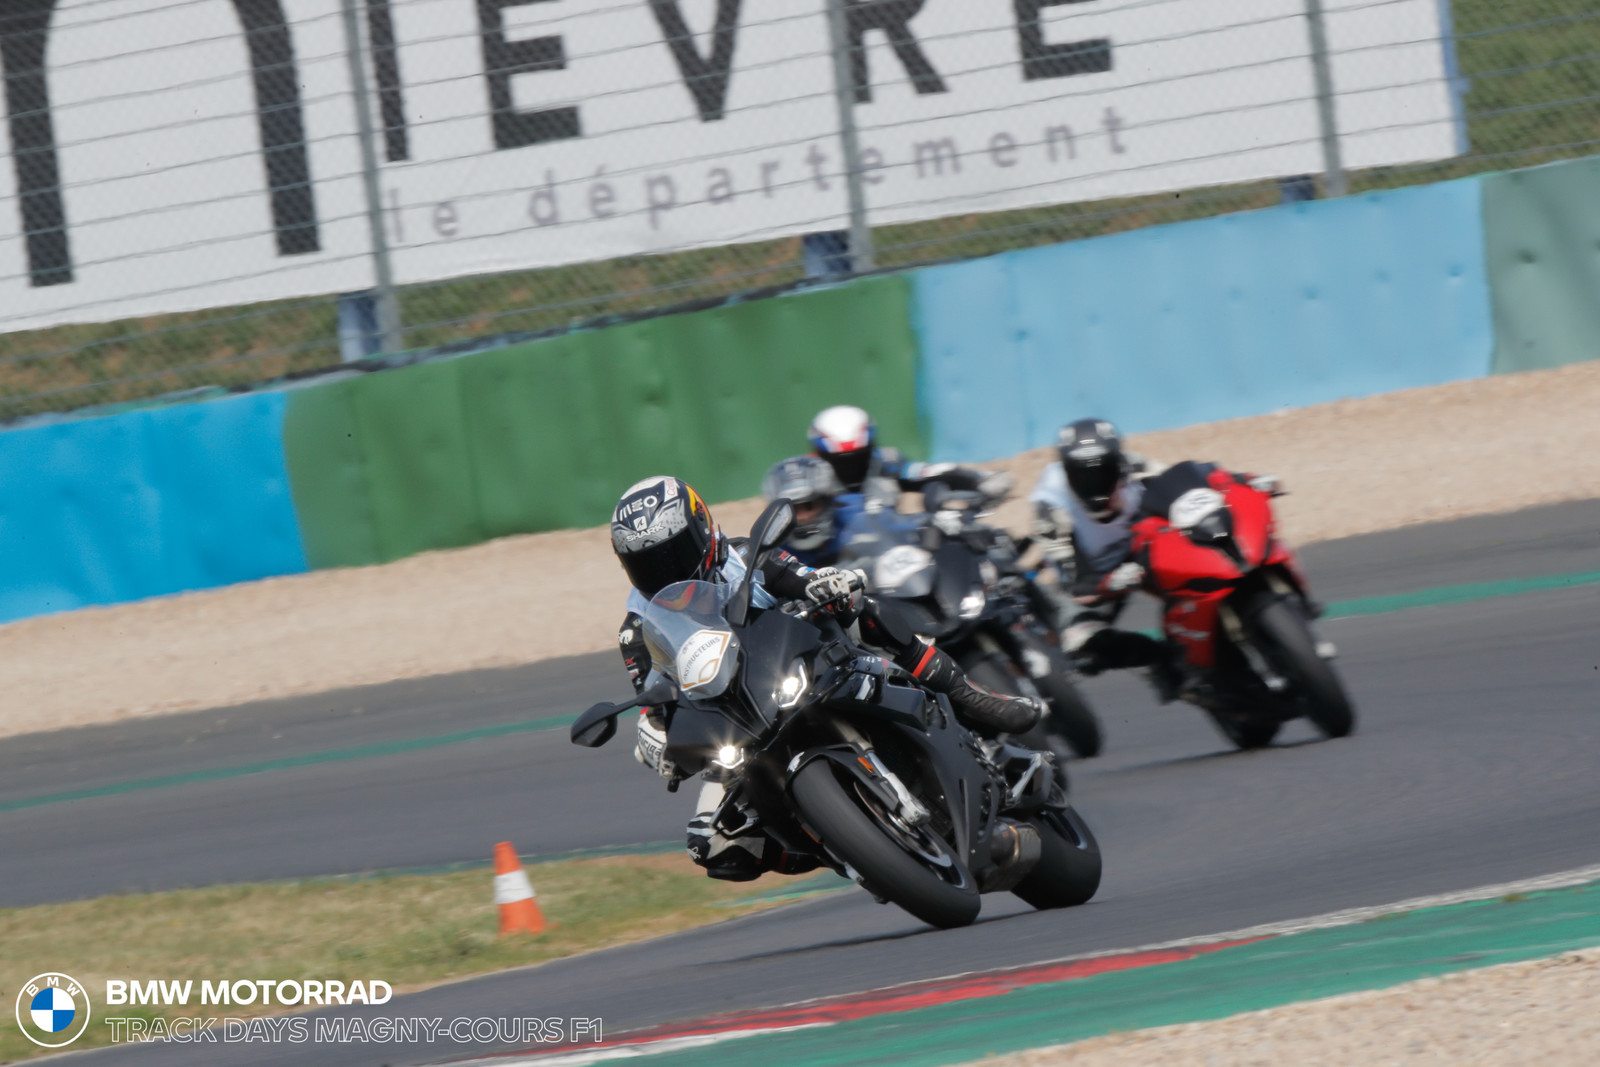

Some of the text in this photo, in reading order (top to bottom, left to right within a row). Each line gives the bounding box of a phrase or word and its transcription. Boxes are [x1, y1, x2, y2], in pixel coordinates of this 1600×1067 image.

[387, 105, 1128, 243] le département
[625, 523, 665, 542] SHARK
